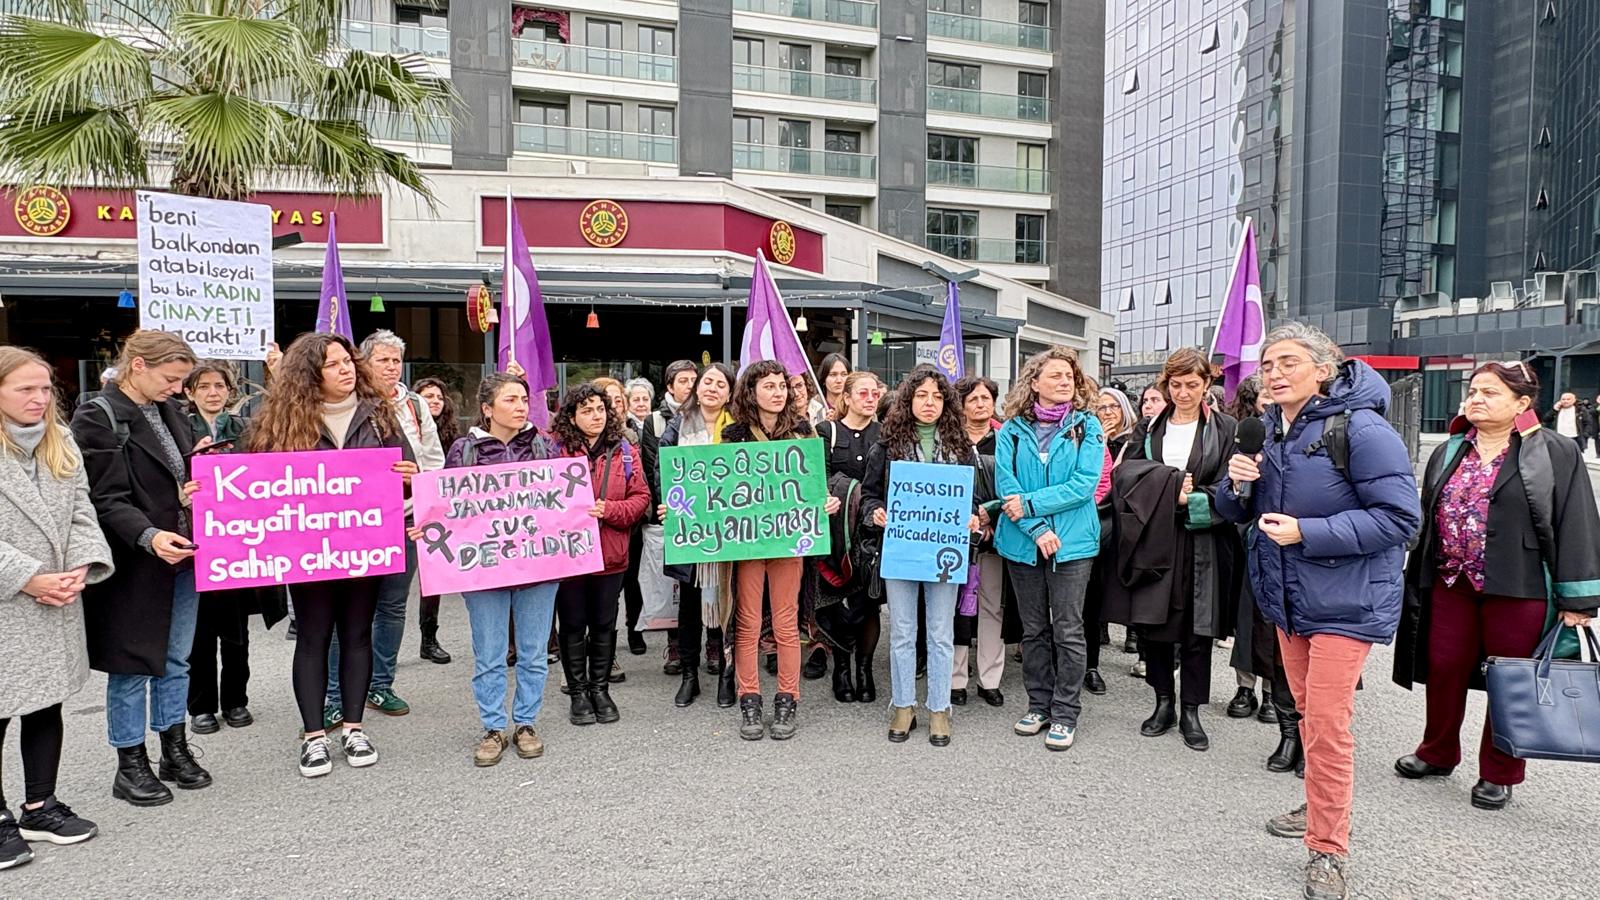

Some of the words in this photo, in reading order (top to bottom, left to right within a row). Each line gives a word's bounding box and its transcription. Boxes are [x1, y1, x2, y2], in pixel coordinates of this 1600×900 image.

[151, 226, 260, 255] balkondan
[149, 255, 254, 281] atabilseydi
[150, 277, 169, 295] bu
[176, 281, 197, 297] bir
[203, 281, 261, 302] KADIN
[148, 300, 252, 326] CİNAYETİ
[672, 445, 810, 483] yaşasın
[213, 463, 362, 502] Kadınlar
[438, 465, 555, 498] HAYATINI
[892, 481, 964, 497] yaşasın
[445, 488, 567, 519] SAVUNMAK
[889, 500, 960, 526] feminist
[205, 503, 382, 545] hayatlarına
[486, 515, 538, 538] SUÇ
[672, 506, 824, 555] dayanışması
[887, 525, 969, 544] mücadelemiz
[208, 548, 292, 582] sahip
[300, 537, 402, 576] çıkıyor
[458, 528, 595, 571] DEĞİLDİR!
